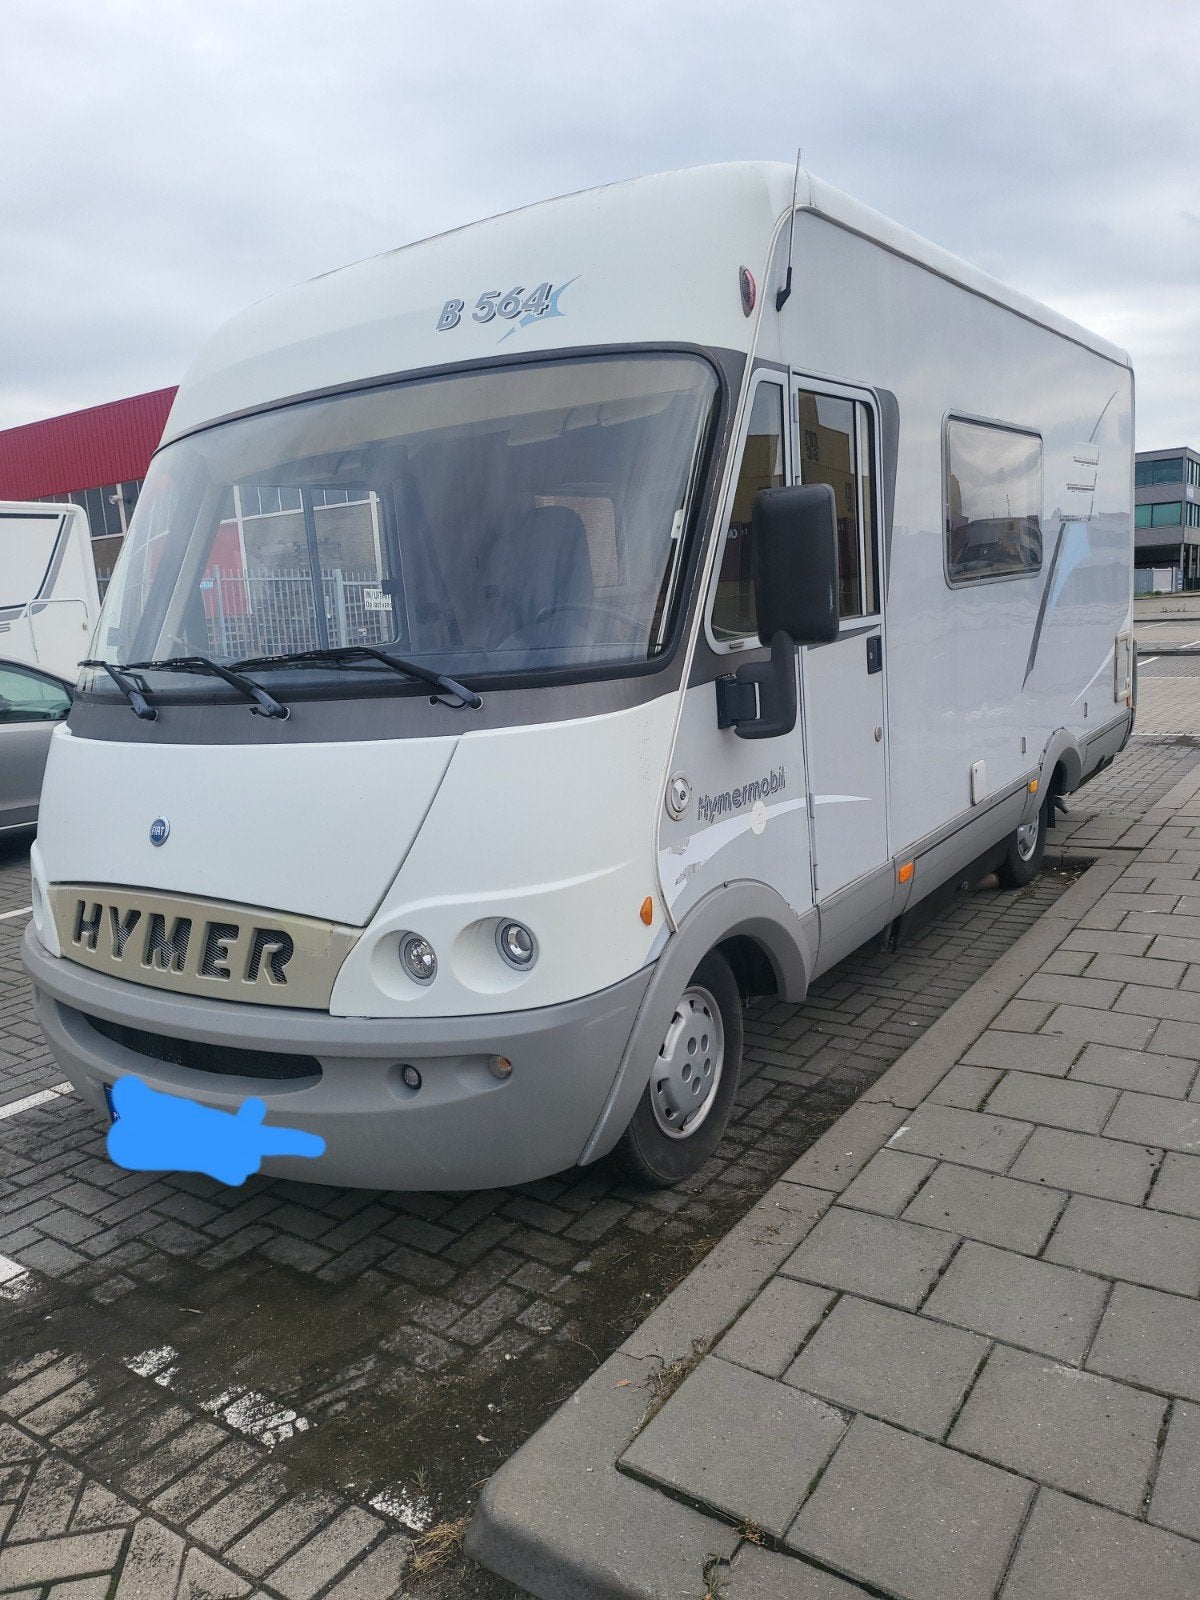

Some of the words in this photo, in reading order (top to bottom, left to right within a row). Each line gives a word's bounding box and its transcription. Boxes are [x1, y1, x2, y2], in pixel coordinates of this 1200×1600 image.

[436, 298, 464, 331] B
[471, 282, 553, 323] 564
[697, 766, 786, 823] Hymermobil
[151, 826, 166, 836] FIAT
[72, 900, 294, 986] HYMER
